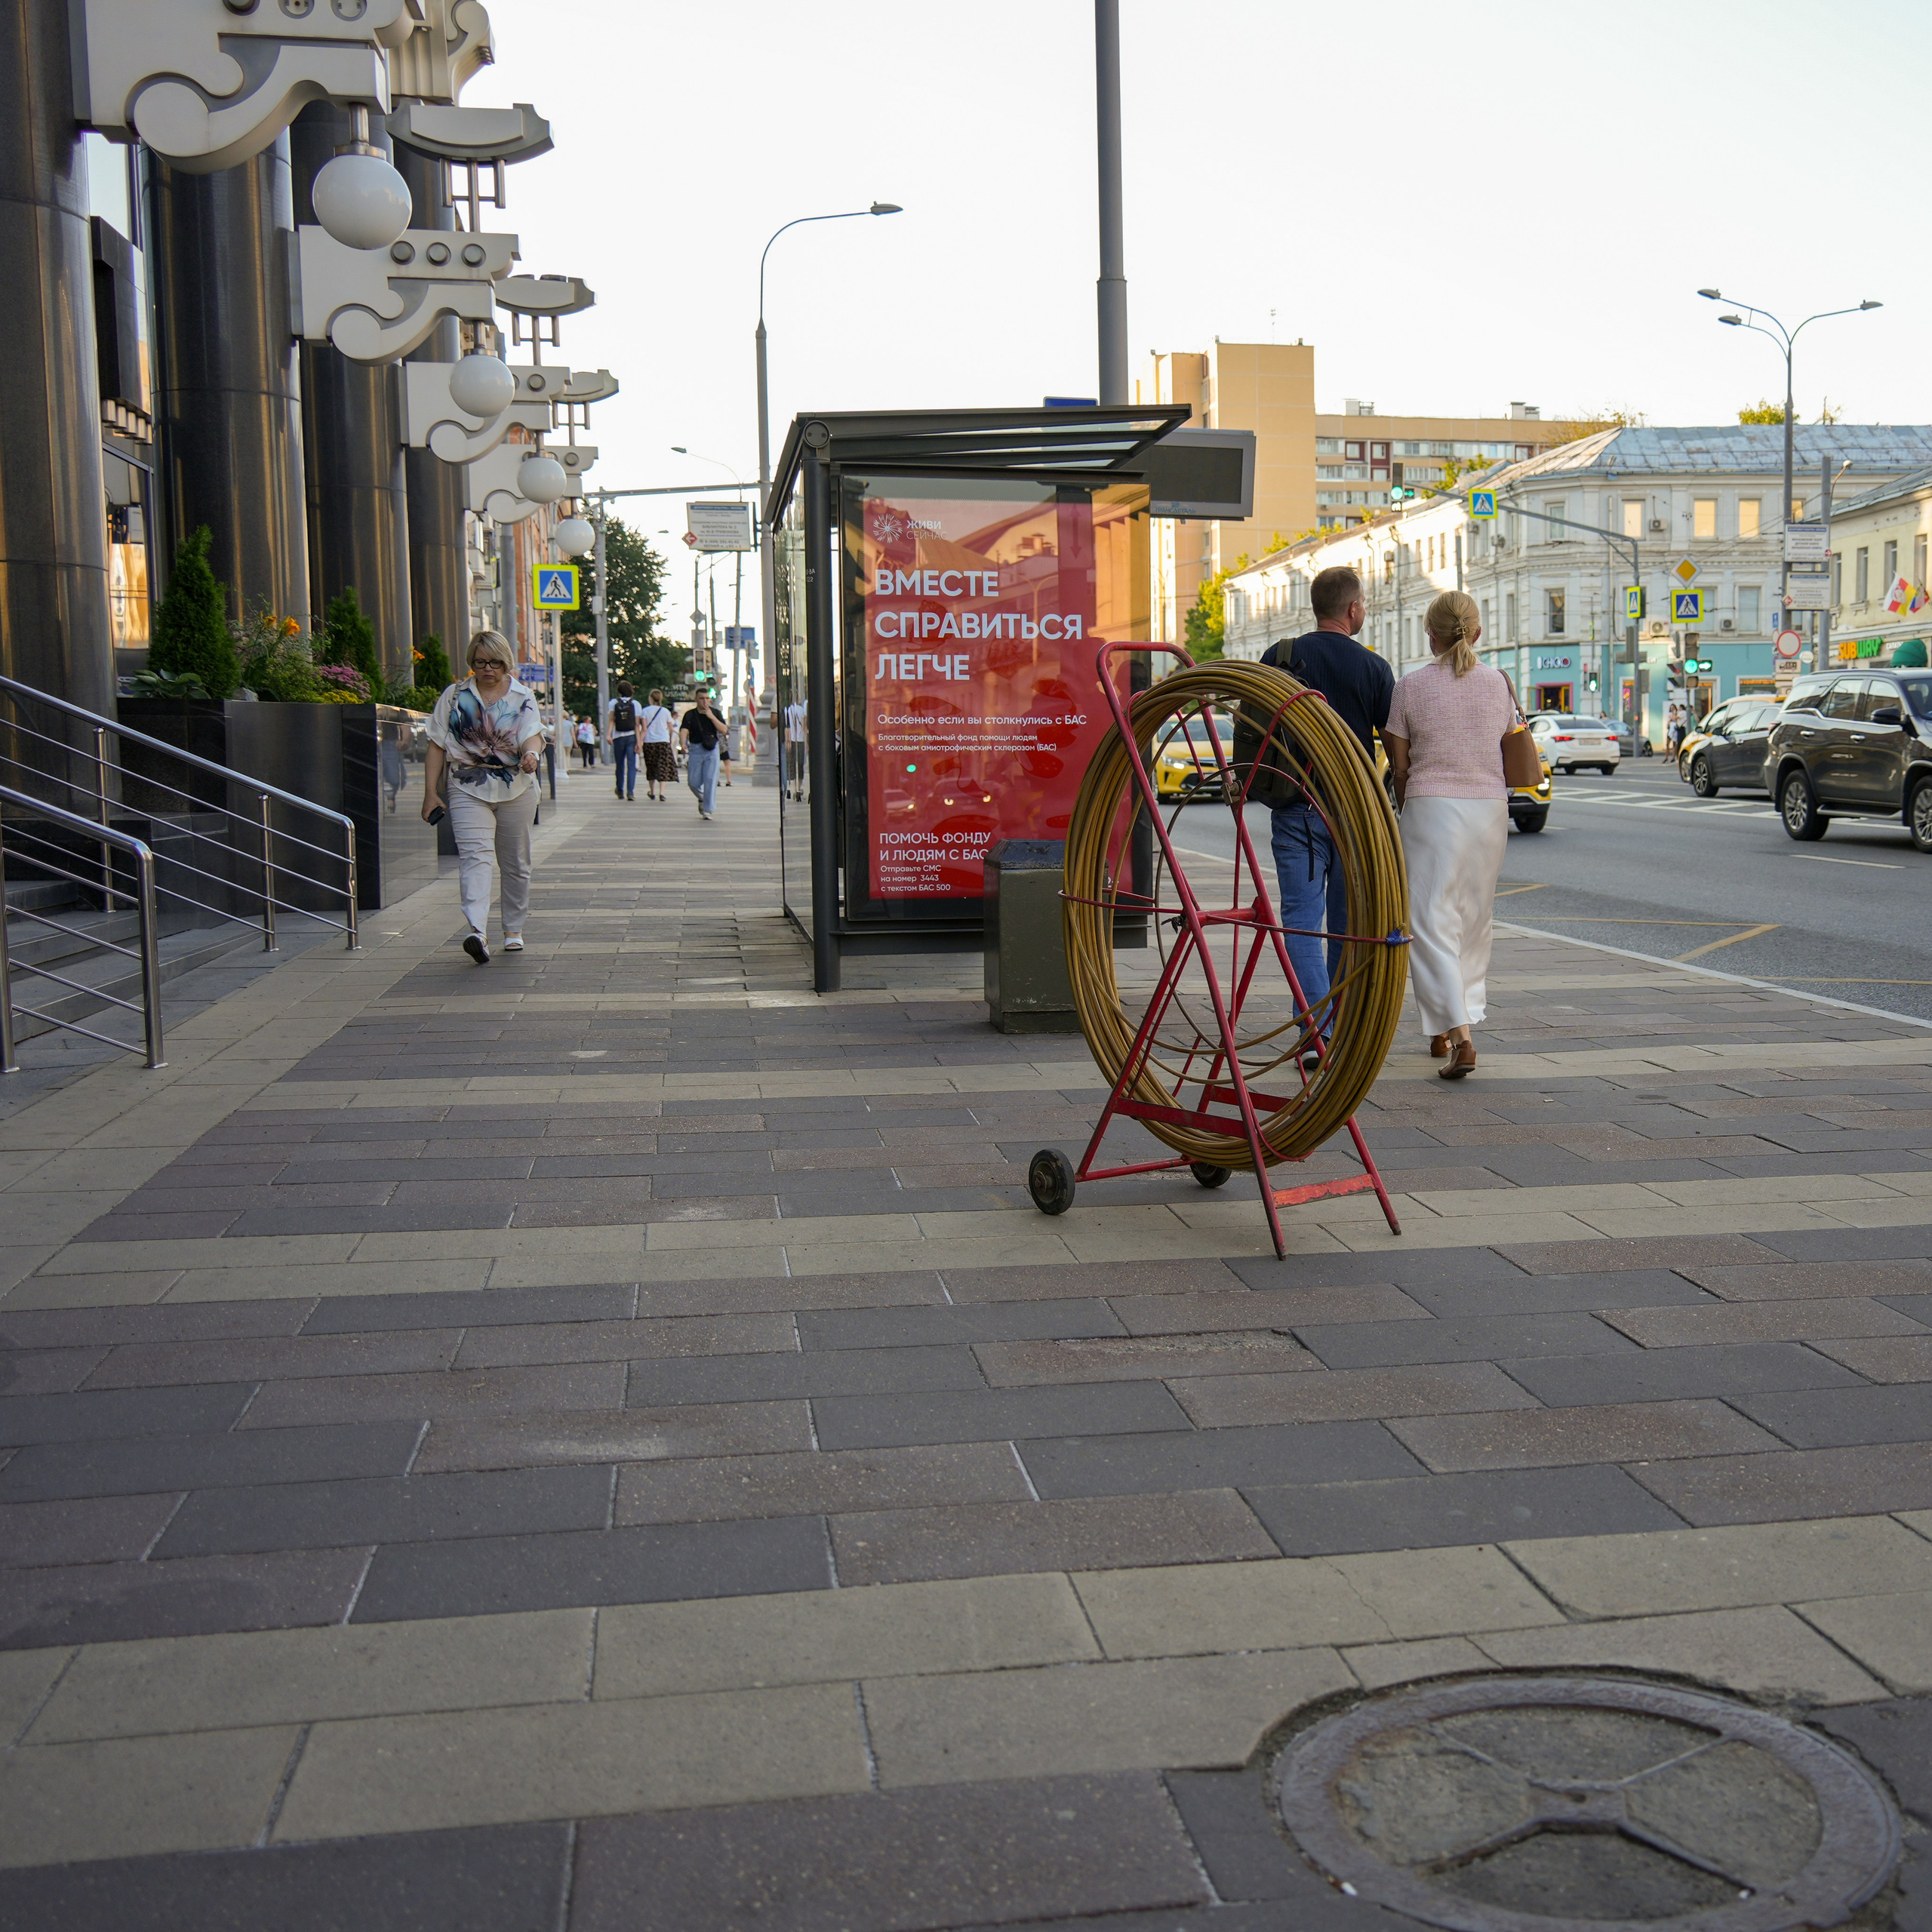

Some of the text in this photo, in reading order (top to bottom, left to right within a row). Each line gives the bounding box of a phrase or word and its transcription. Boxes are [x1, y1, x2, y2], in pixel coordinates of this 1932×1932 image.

[906, 520, 941, 529] ЖИВИ
[906, 529, 948, 540] СЕЙЧАС
[875, 569, 999, 597] ВМЕСТЕ
[875, 611, 1083, 640] СПРАВИТЬСЯ
[1837, 636, 1883, 661] SUBWAY
[875, 654, 971, 680] ЛЕГЧЕ
[878, 714, 935, 724] Особенно
[938, 716, 964, 724] если
[968, 716, 982, 724] вы
[984, 716, 1053, 727] столкнулись
[1064, 715, 1087, 724] БАС
[878, 734, 955, 742] Благотворительный
[957, 734, 978, 742] фонд
[921, 744, 992, 752] амиотрофическим
[994, 744, 1035, 752] склерозом
[1037, 743, 1057, 752] (БАС)
[879, 832, 991, 845] ПОМОЧЬ ФОНДУ
[880, 849, 989, 862] И ЛЮДЯМ С БАС
[880, 865, 921, 873] Отправьте
